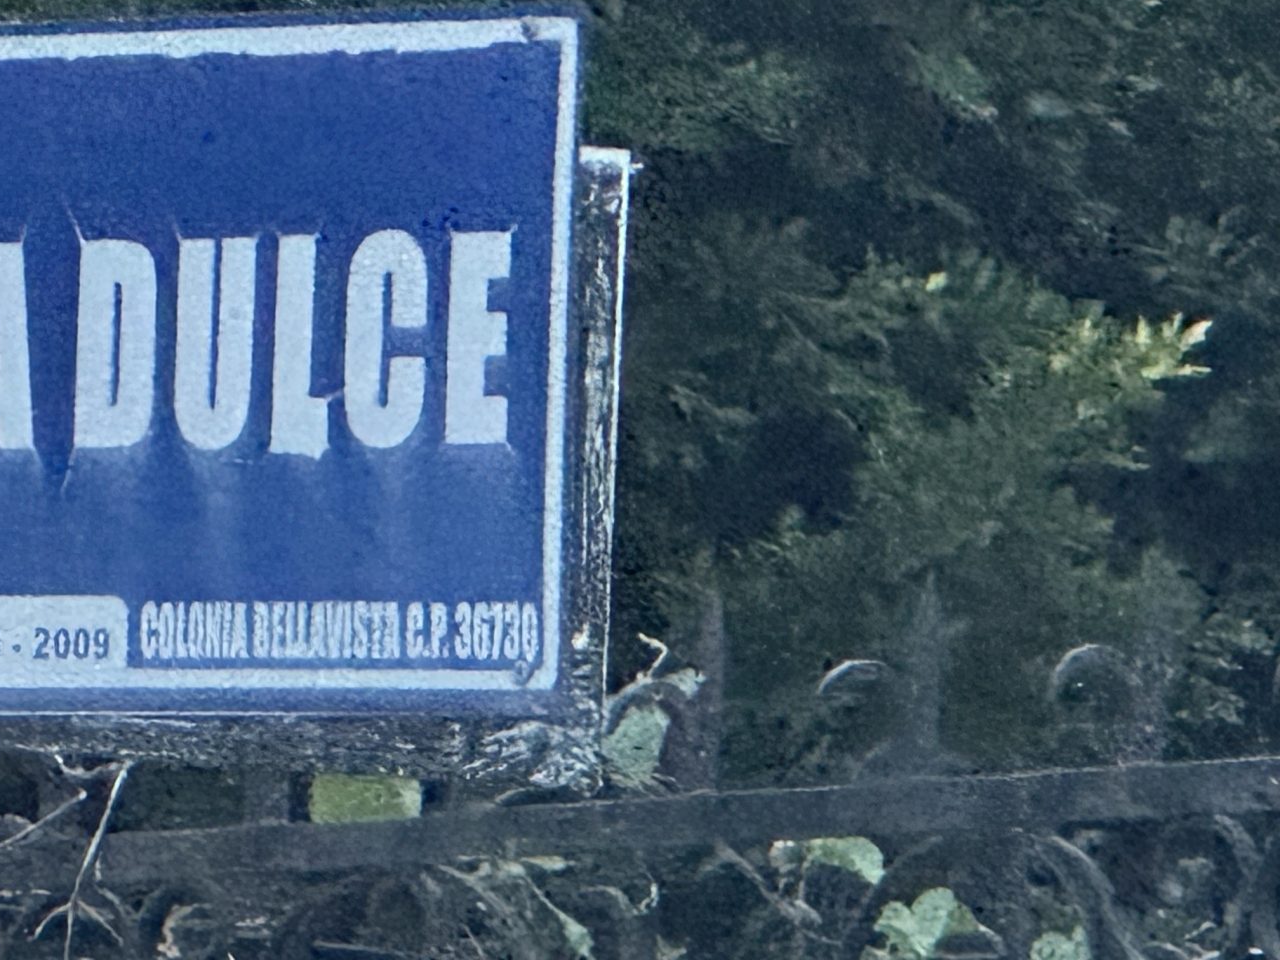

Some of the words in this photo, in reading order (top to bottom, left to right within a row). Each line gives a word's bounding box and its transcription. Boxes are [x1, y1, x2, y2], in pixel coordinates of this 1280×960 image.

[72, 228, 515, 458] DULCE
[32, 626, 111, 659] 2009
[139, 601, 249, 660] COLONIA
[253, 601, 401, 659] BELLAVISTA
[406, 601, 450, 659] C.P.
[454, 600, 540, 662] 36730
